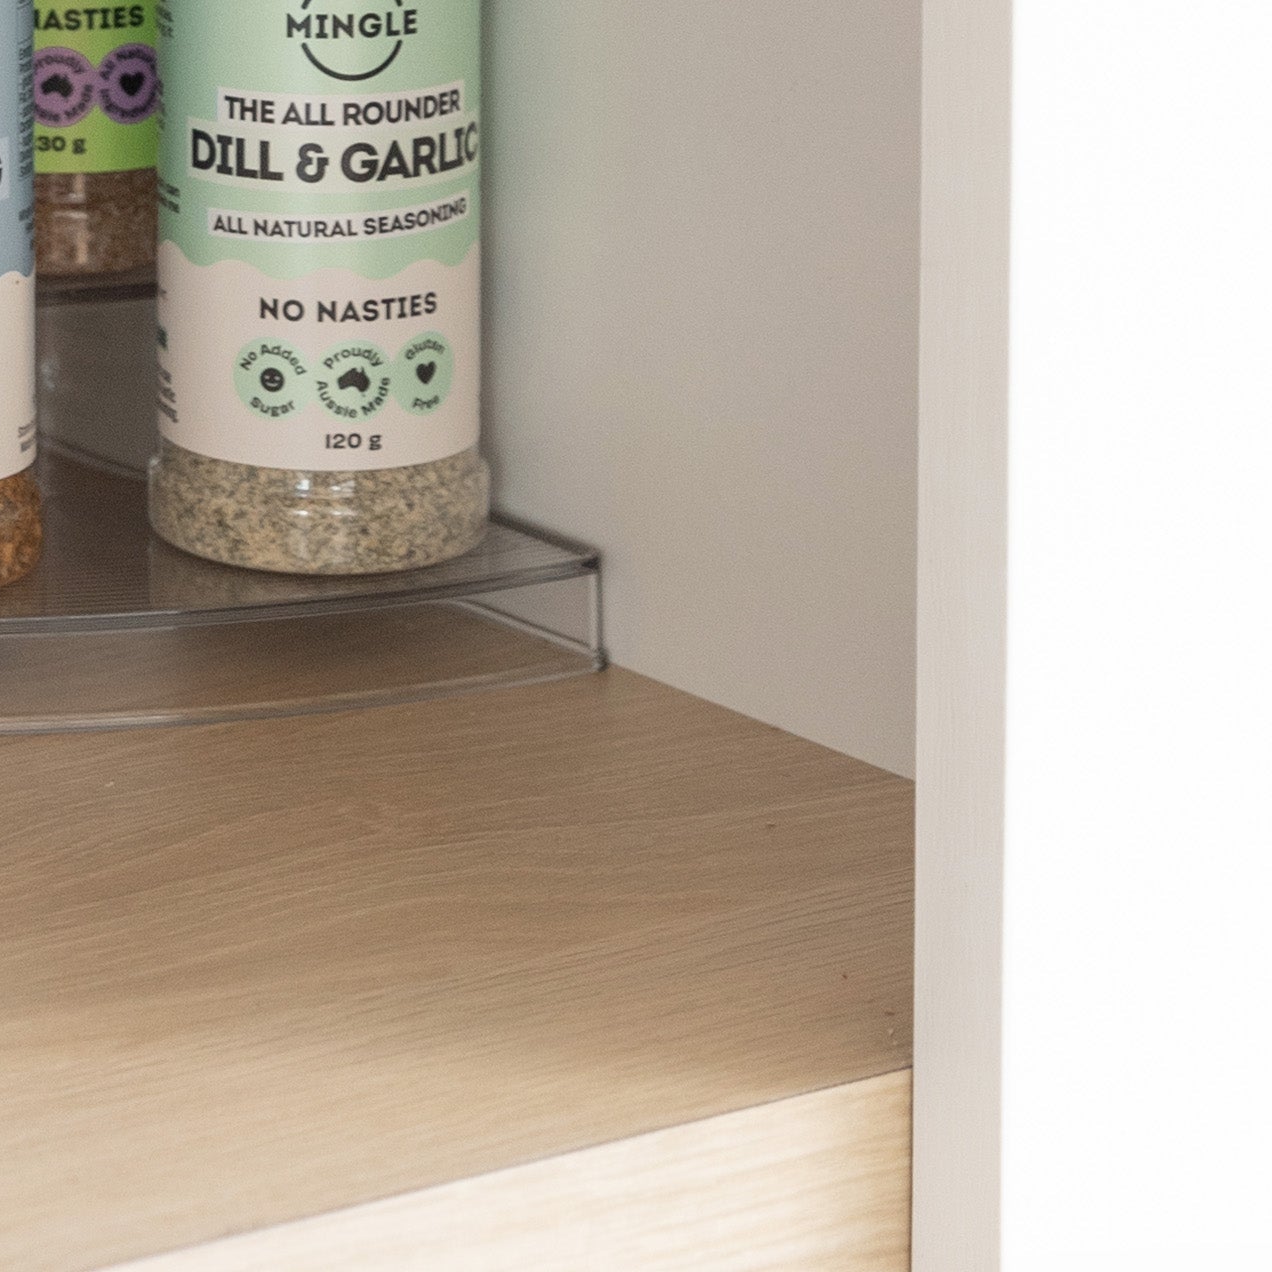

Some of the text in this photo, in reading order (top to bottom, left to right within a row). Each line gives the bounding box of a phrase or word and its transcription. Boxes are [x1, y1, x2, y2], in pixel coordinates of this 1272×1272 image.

[286, 9, 418, 39] MINGLE
[224, 89, 460, 127] THE ALL ROUNDER
[37, 136, 87, 155] 30 g
[191, 121, 478, 183] DILL & GARLIC
[213, 197, 467, 238] ALL NATURAL SEASONING
[259, 291, 437, 323] NO NASTIES
[239, 343, 307, 377] No Added
[323, 347, 384, 370] Proudly
[250, 396, 295, 418] Sugar
[316, 377, 391, 419] Aussie Made
[325, 432, 382, 451] 120 g
